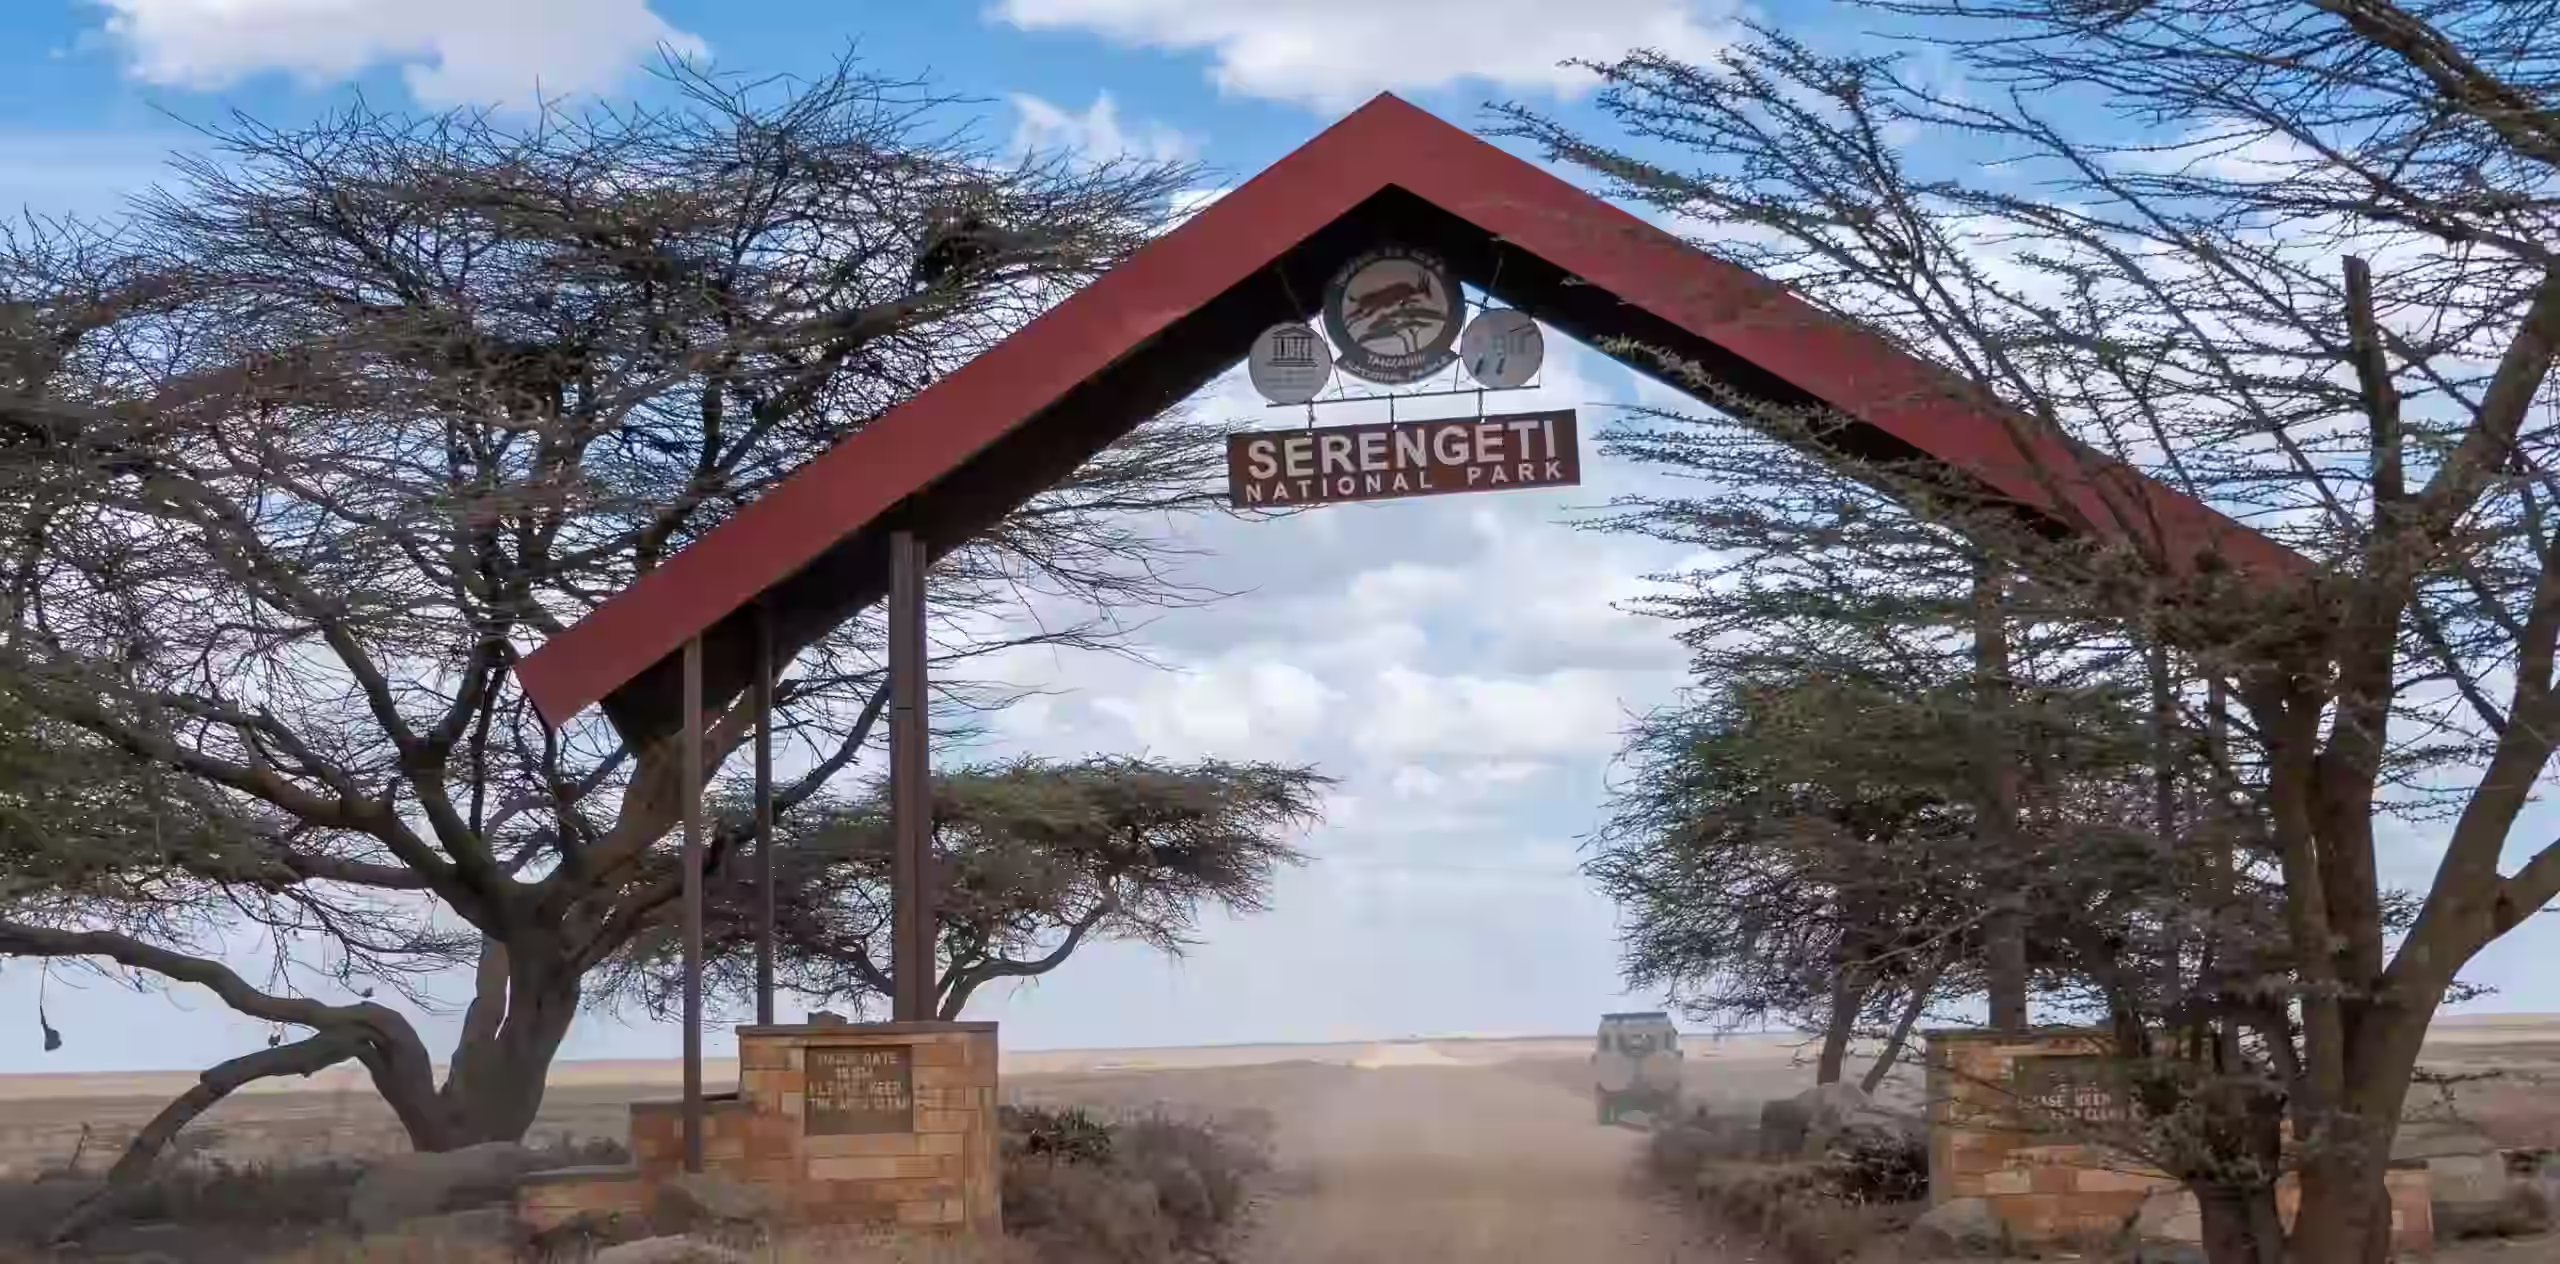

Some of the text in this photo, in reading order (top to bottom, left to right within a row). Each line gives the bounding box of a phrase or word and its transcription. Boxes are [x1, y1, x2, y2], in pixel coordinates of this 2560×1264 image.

[1247, 420, 1556, 479] SERENGETI
[1245, 459, 1564, 503] NATIONAL PARK
